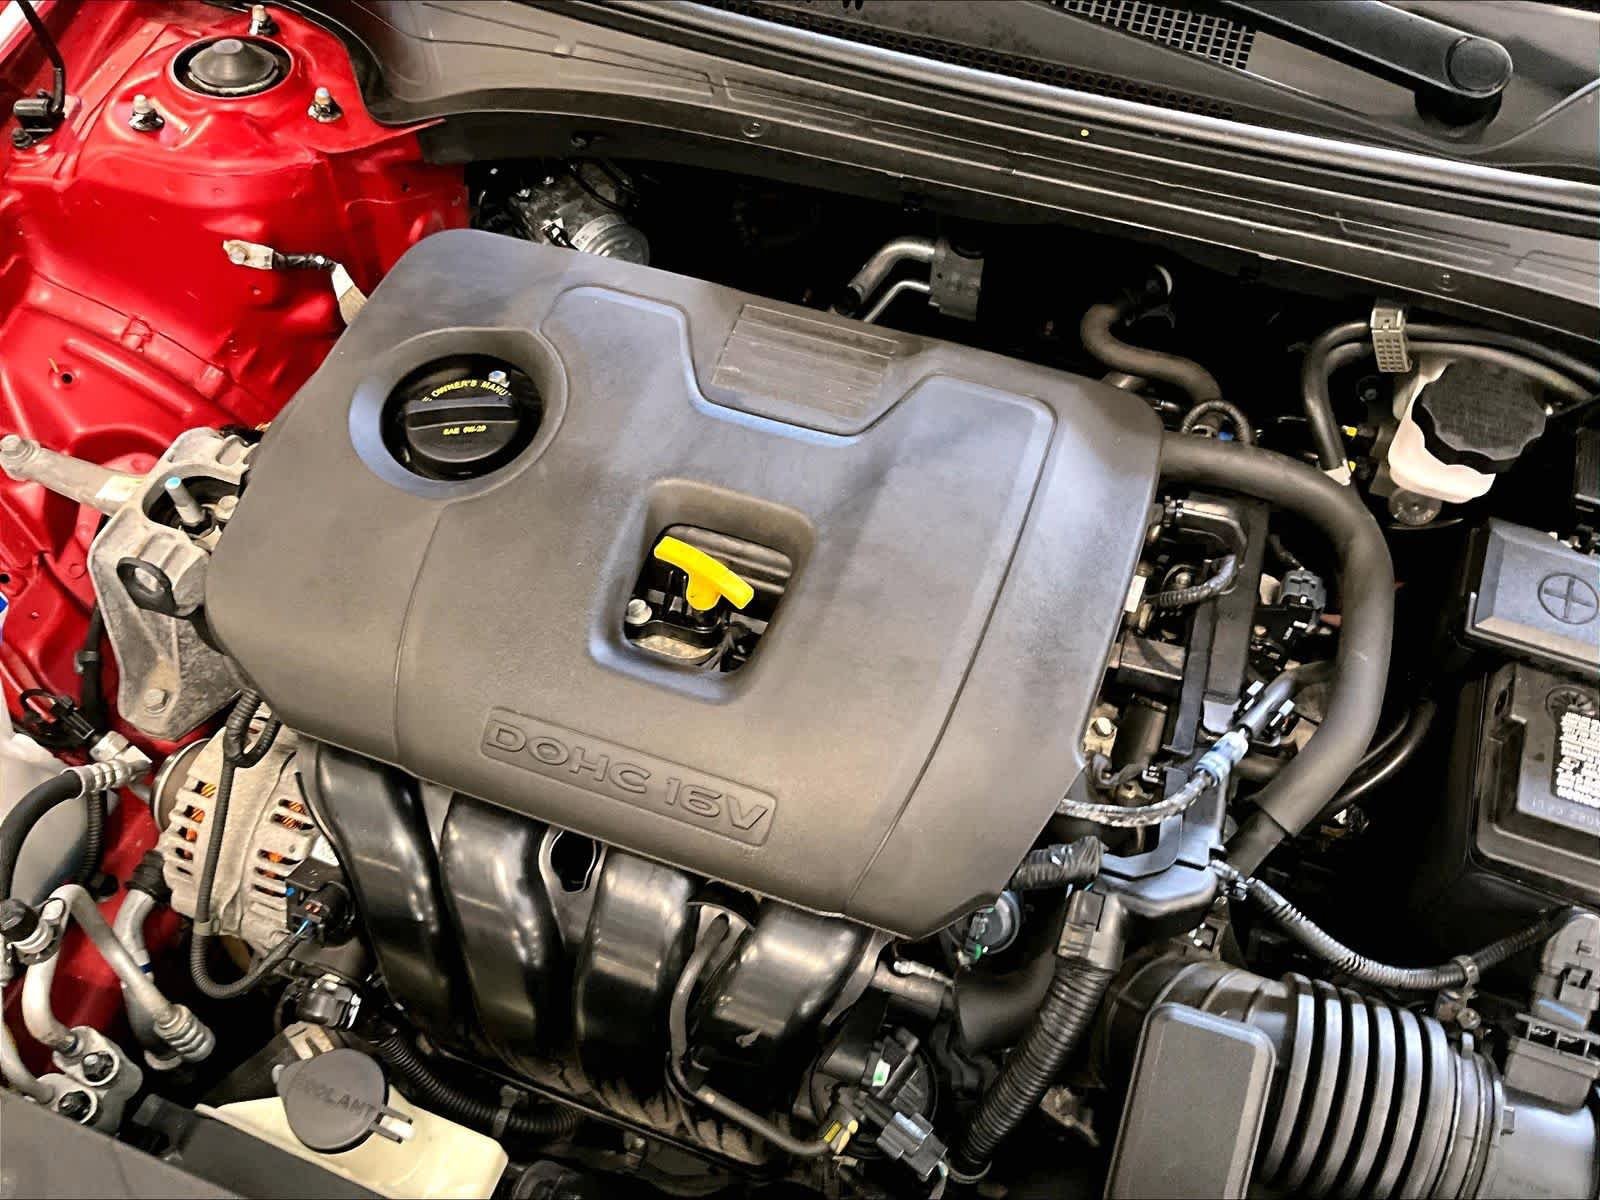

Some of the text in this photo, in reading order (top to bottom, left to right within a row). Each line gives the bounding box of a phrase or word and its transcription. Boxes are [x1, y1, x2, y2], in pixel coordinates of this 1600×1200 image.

[481, 381, 512, 396] MANU
[443, 427, 460, 435] SAE
[486, 719, 768, 830] DOHC 16V
